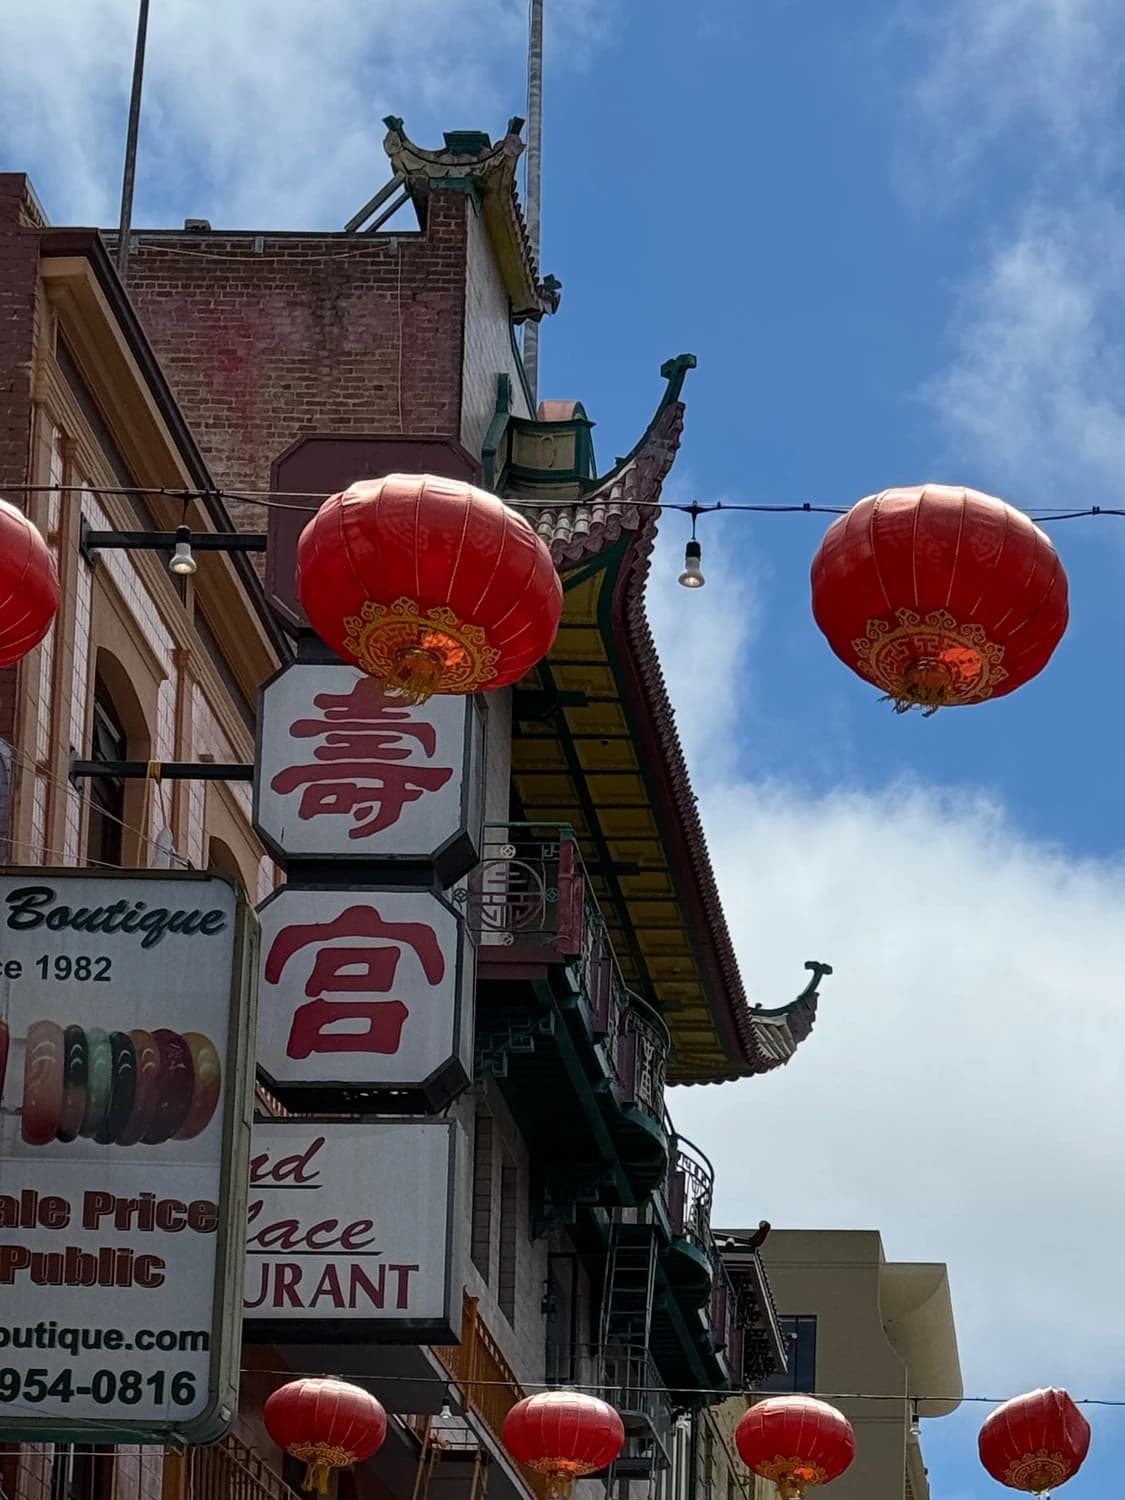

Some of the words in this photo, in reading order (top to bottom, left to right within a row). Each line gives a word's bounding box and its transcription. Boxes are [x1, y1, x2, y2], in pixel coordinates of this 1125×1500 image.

[7, 887, 227, 948] Boutique
[36, 955, 112, 982] 1982
[82, 1191, 219, 1233] Price
[0, 1245, 165, 1288] Public
